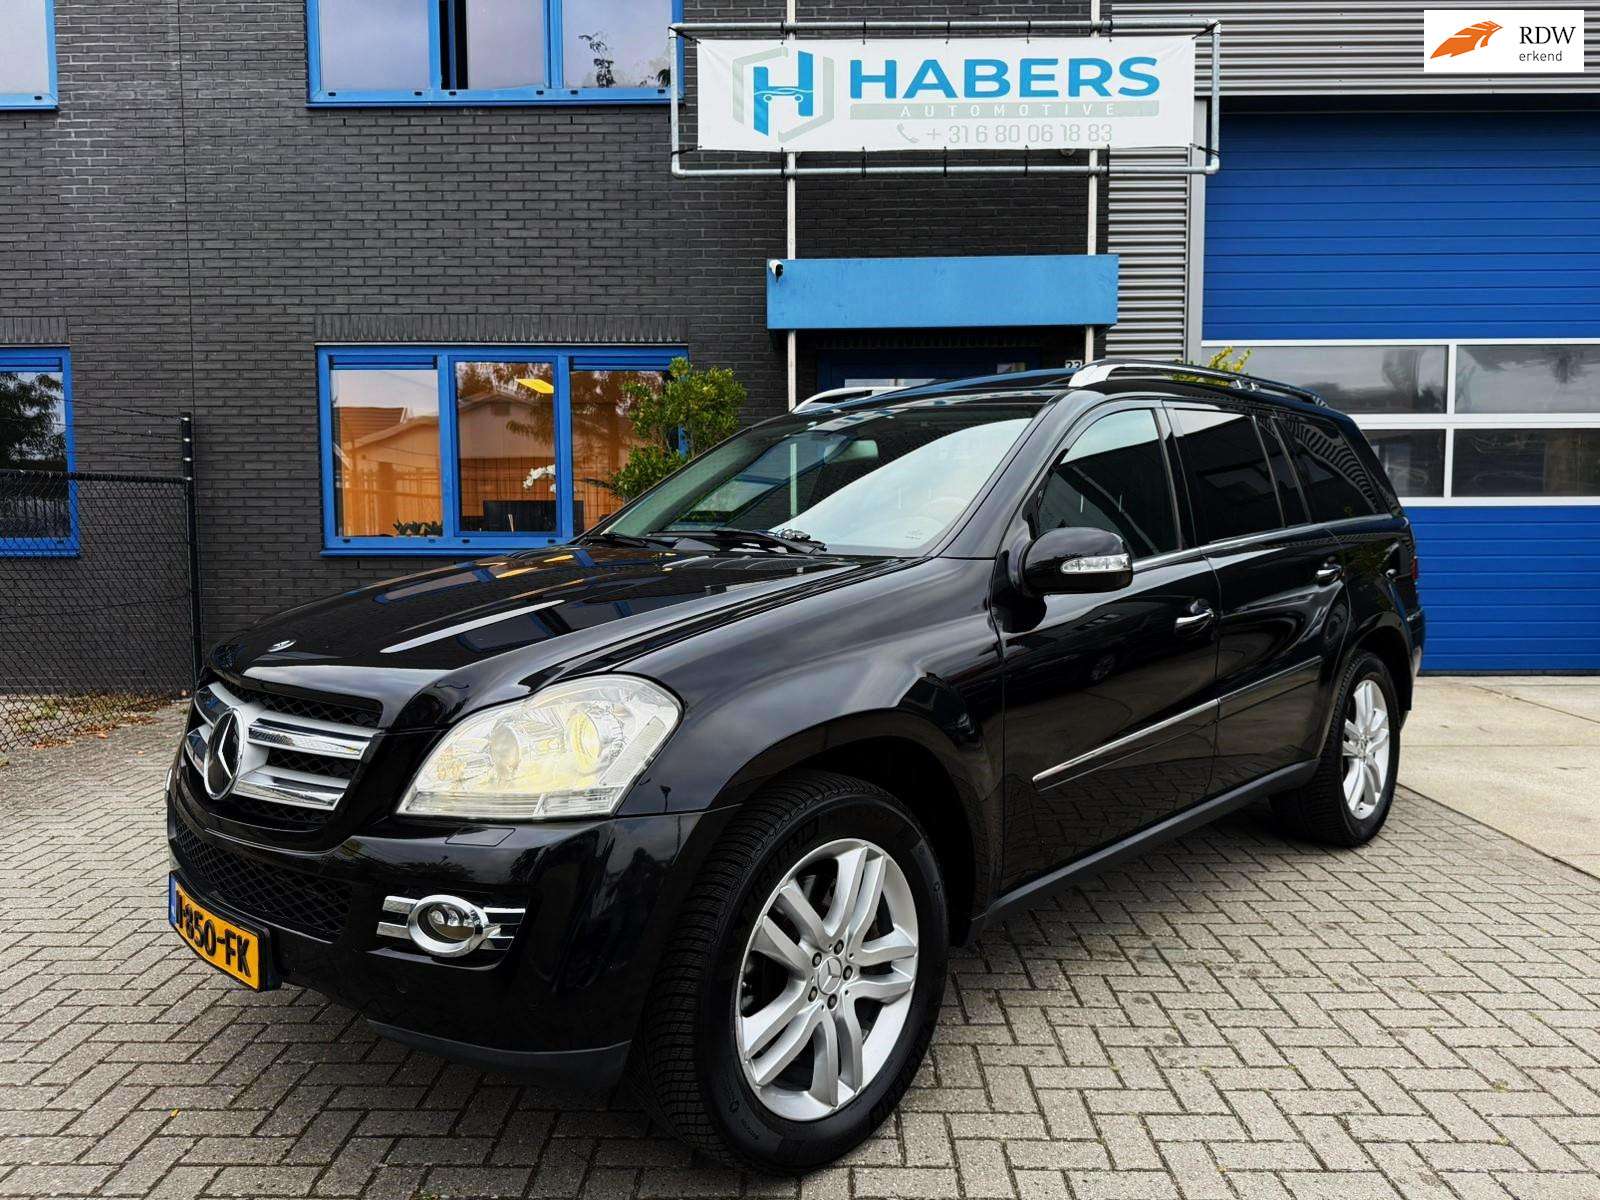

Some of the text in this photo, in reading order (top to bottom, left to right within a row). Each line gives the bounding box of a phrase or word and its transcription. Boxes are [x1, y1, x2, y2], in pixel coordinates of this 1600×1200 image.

[850, 56, 1160, 99] HABERS
[900, 103, 1114, 118] AUTOMOTIVE
[994, 124, 1020, 143] 80
[1028, 124, 1053, 143] 06
[1060, 124, 1081, 143] 18
[1087, 123, 1112, 143] 83
